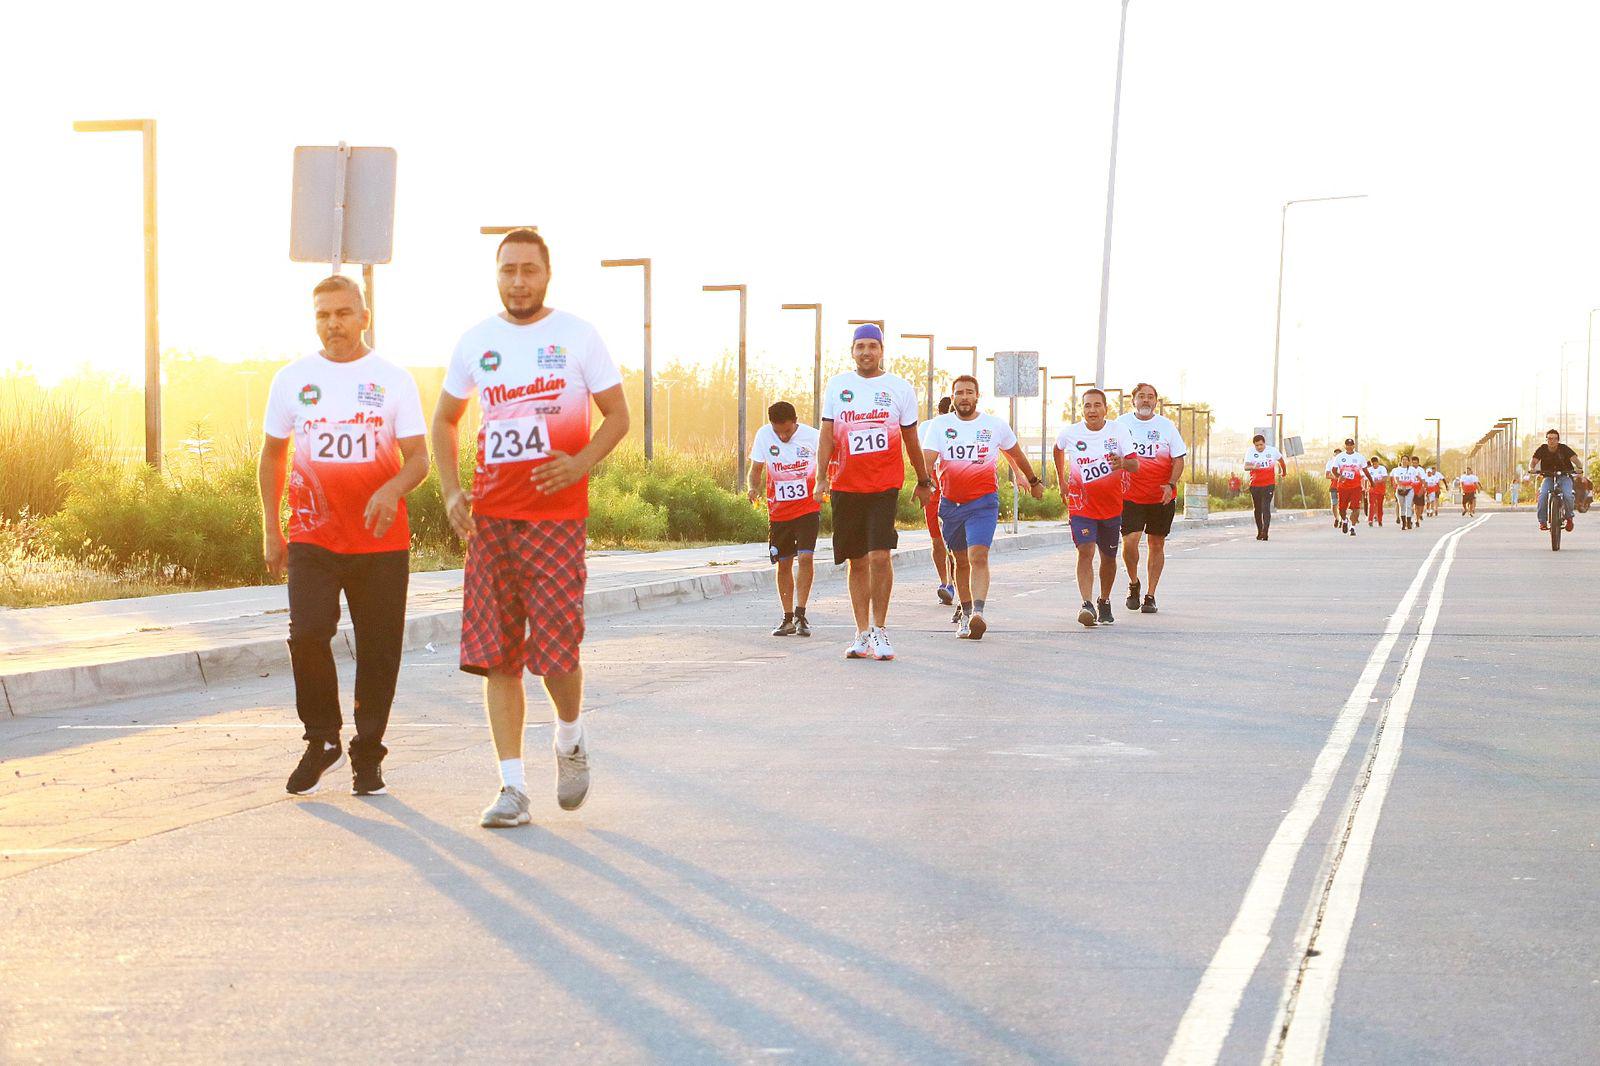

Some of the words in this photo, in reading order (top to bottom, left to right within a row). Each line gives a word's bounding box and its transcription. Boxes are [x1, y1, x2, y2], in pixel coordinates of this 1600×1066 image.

[482, 373, 567, 406] Mazatlán
[840, 408, 890, 423] Mazatlán
[318, 433, 368, 459] 201
[490, 425, 545, 458] 234
[853, 433, 886, 451] 216
[947, 445, 976, 459] 197
[772, 459, 809, 472] Mazatlán
[1083, 462, 1109, 481] 206
[779, 484, 806, 499] 133
